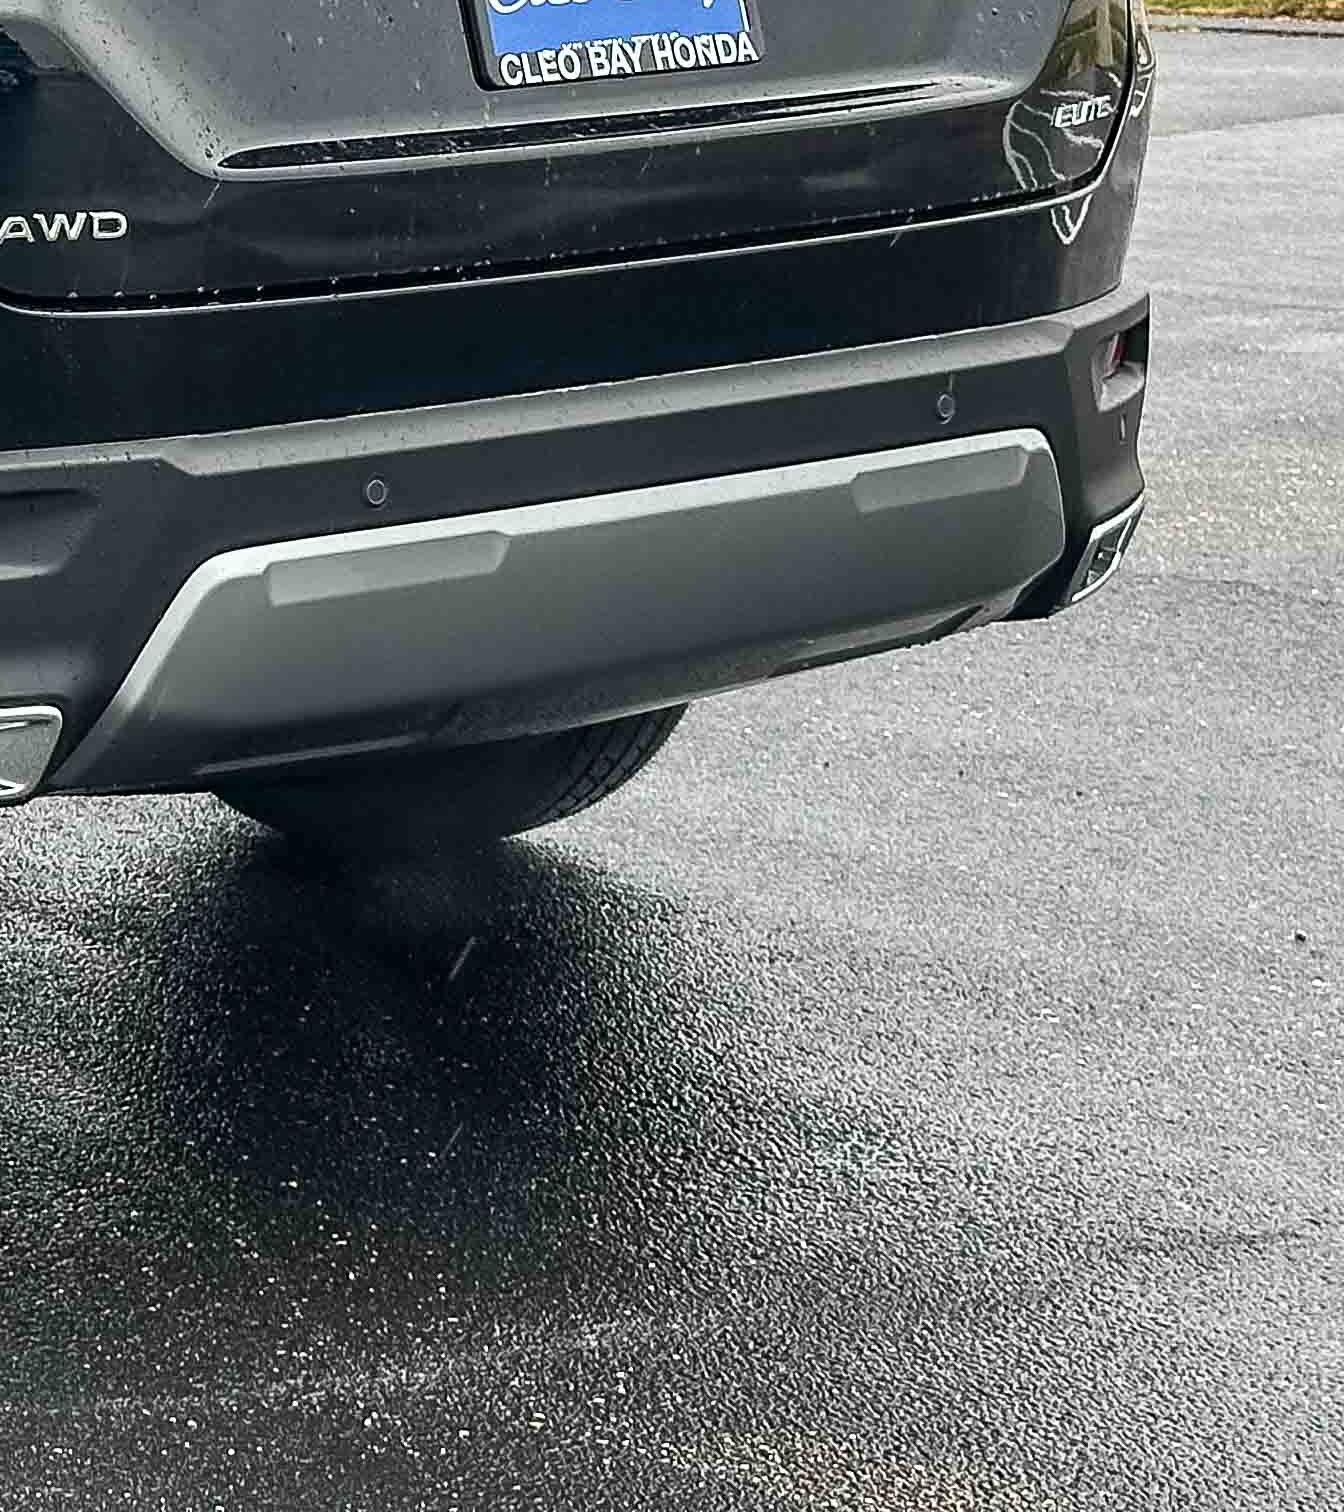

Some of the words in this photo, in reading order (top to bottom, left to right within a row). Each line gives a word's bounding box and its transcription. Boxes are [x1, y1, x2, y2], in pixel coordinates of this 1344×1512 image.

[499, 48, 581, 86] CLEO
[588, 40, 646, 77] BAY
[650, 32, 760, 71] HONDA
